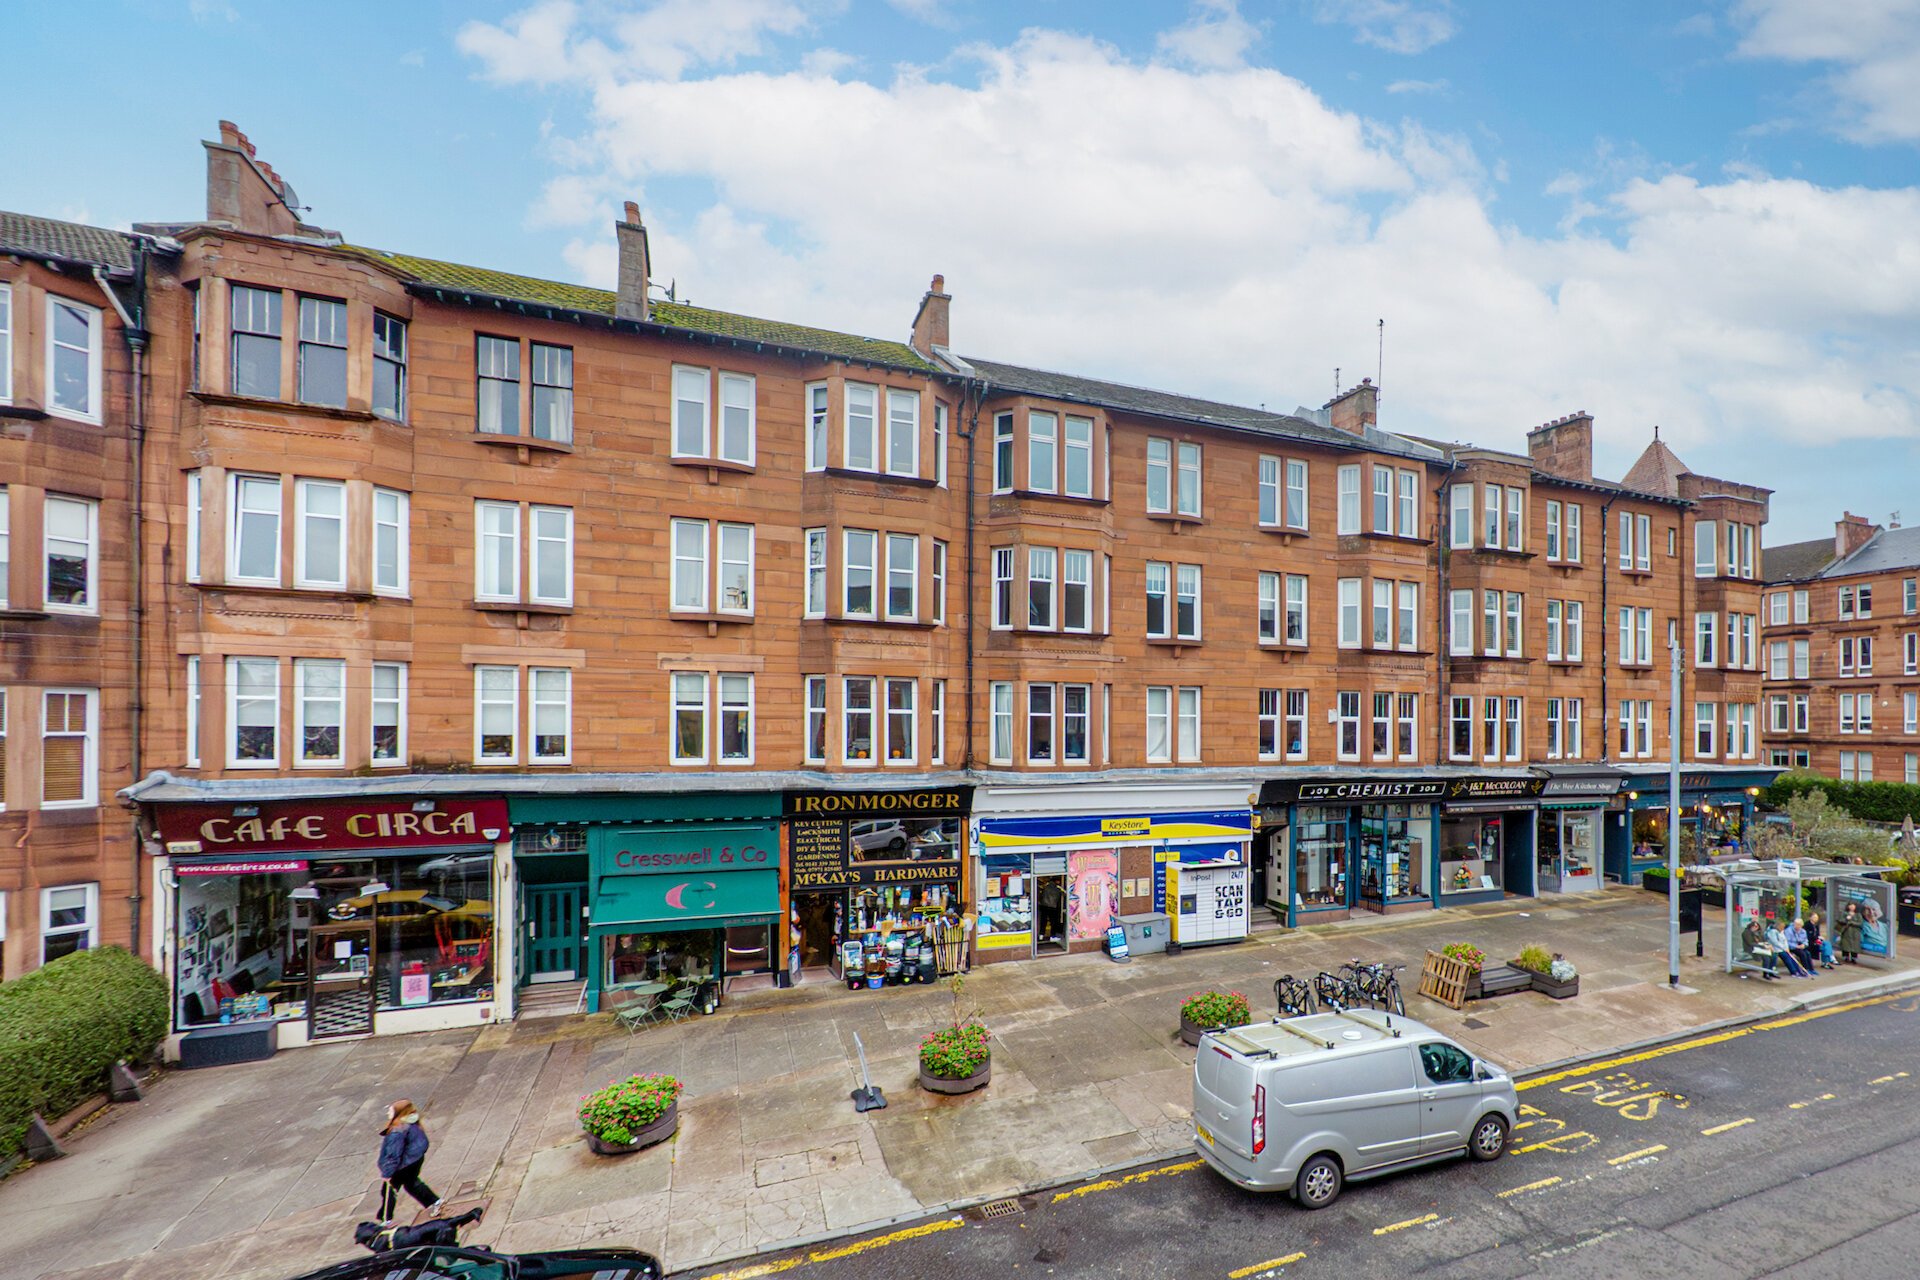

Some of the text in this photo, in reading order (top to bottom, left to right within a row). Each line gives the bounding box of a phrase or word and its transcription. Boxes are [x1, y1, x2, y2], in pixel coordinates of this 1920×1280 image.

[1337, 784, 1415, 796] CHEMIST
[1468, 780, 1528, 792] J&T McCOLGAN
[1550, 783, 1560, 791] The
[1597, 782, 1612, 791] Shop
[794, 794, 960, 812] IRONMONGER
[346, 812, 477, 838] CIRCA
[1109, 821, 1144, 830] KeyStore
[796, 836, 842, 844] ELECTRICAL
[615, 845, 767, 868] Cresswell & Co
[796, 853, 840, 861] GARDENING
[178, 862, 299, 872] www.cafecirca.co.uk
[795, 866, 959, 885] McKAY'S HARDWARE
[1190, 874, 1211, 882] InPost
[1231, 871, 1244, 879] 24/7
[1215, 884, 1243, 898] SCAN
[1215, 897, 1243, 909] TAP
[1559, 1072, 1692, 1121] BUS
